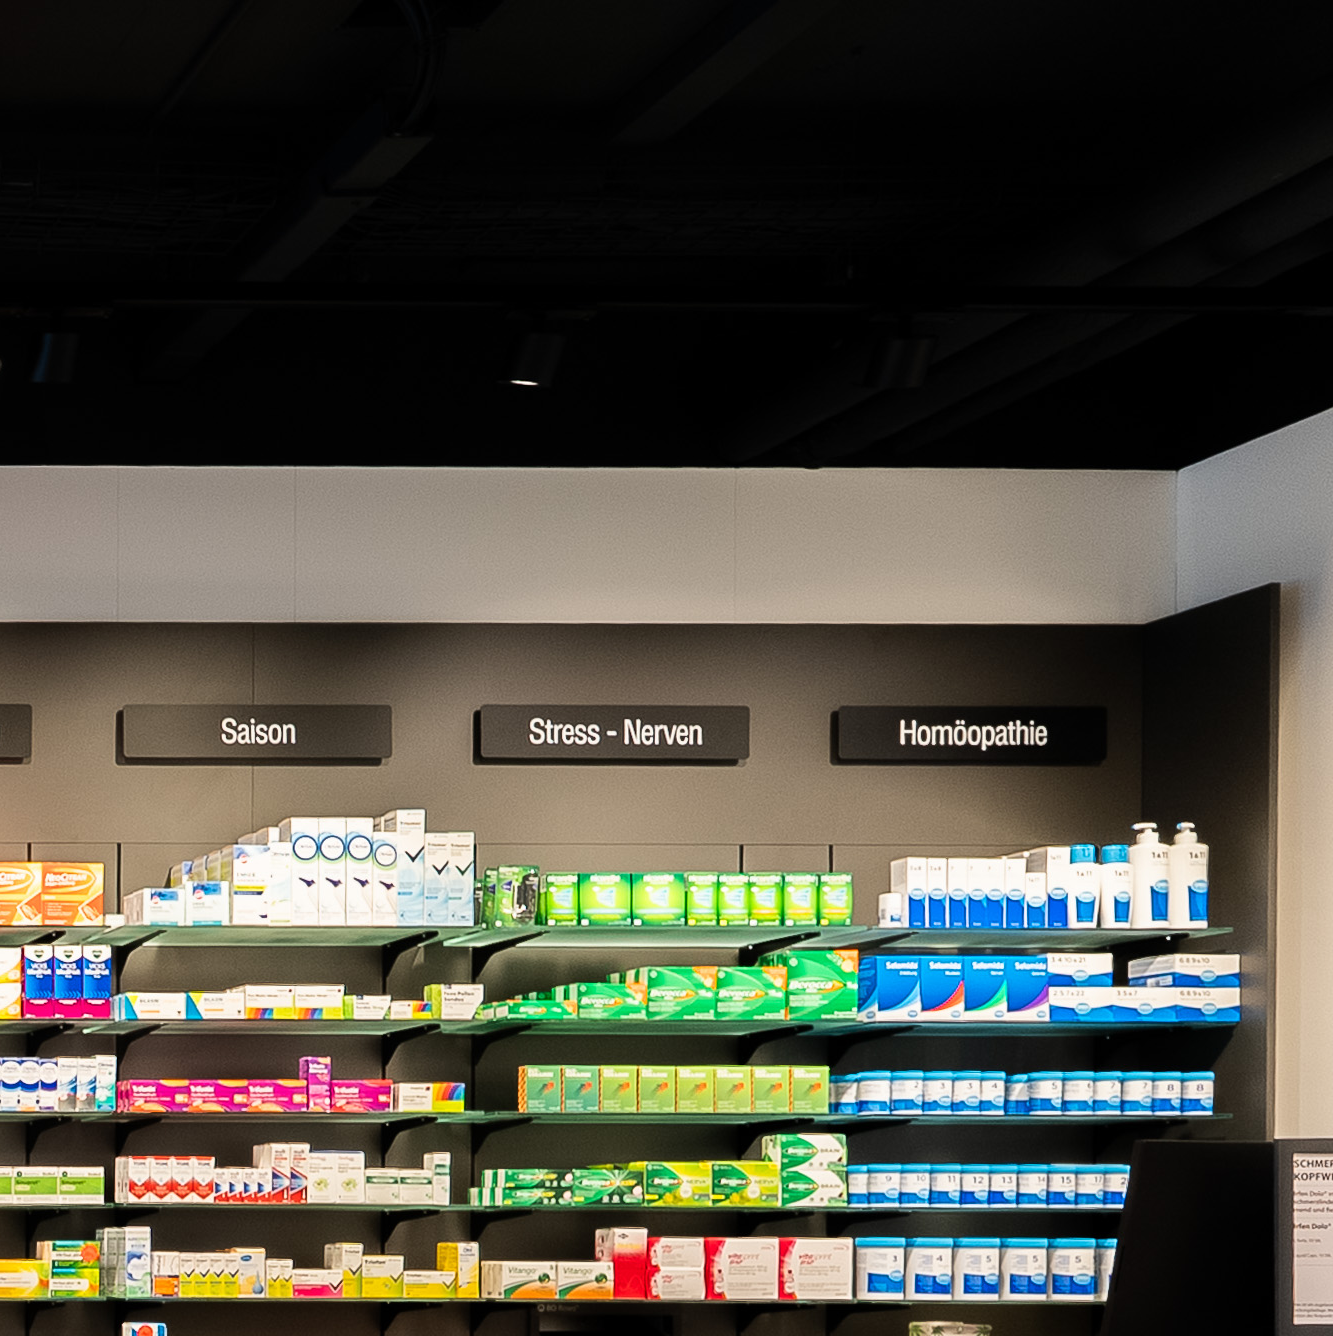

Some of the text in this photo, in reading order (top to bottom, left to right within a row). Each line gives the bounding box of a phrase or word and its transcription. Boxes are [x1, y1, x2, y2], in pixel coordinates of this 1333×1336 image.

[221, 717, 296, 745] Saison
[529, 717, 601, 745] Stress
[623, 718, 703, 746] Nerven
[899, 718, 1048, 752] Homöopathie
[789, 980, 833, 990] Berocca
[650, 989, 687, 998] Berocca
[718, 989, 756, 998] Berocca
[1060, 1176, 1072, 1184] 15
[508, 1266, 537, 1275] Vitango
[561, 1266, 591, 1275] Vitango
